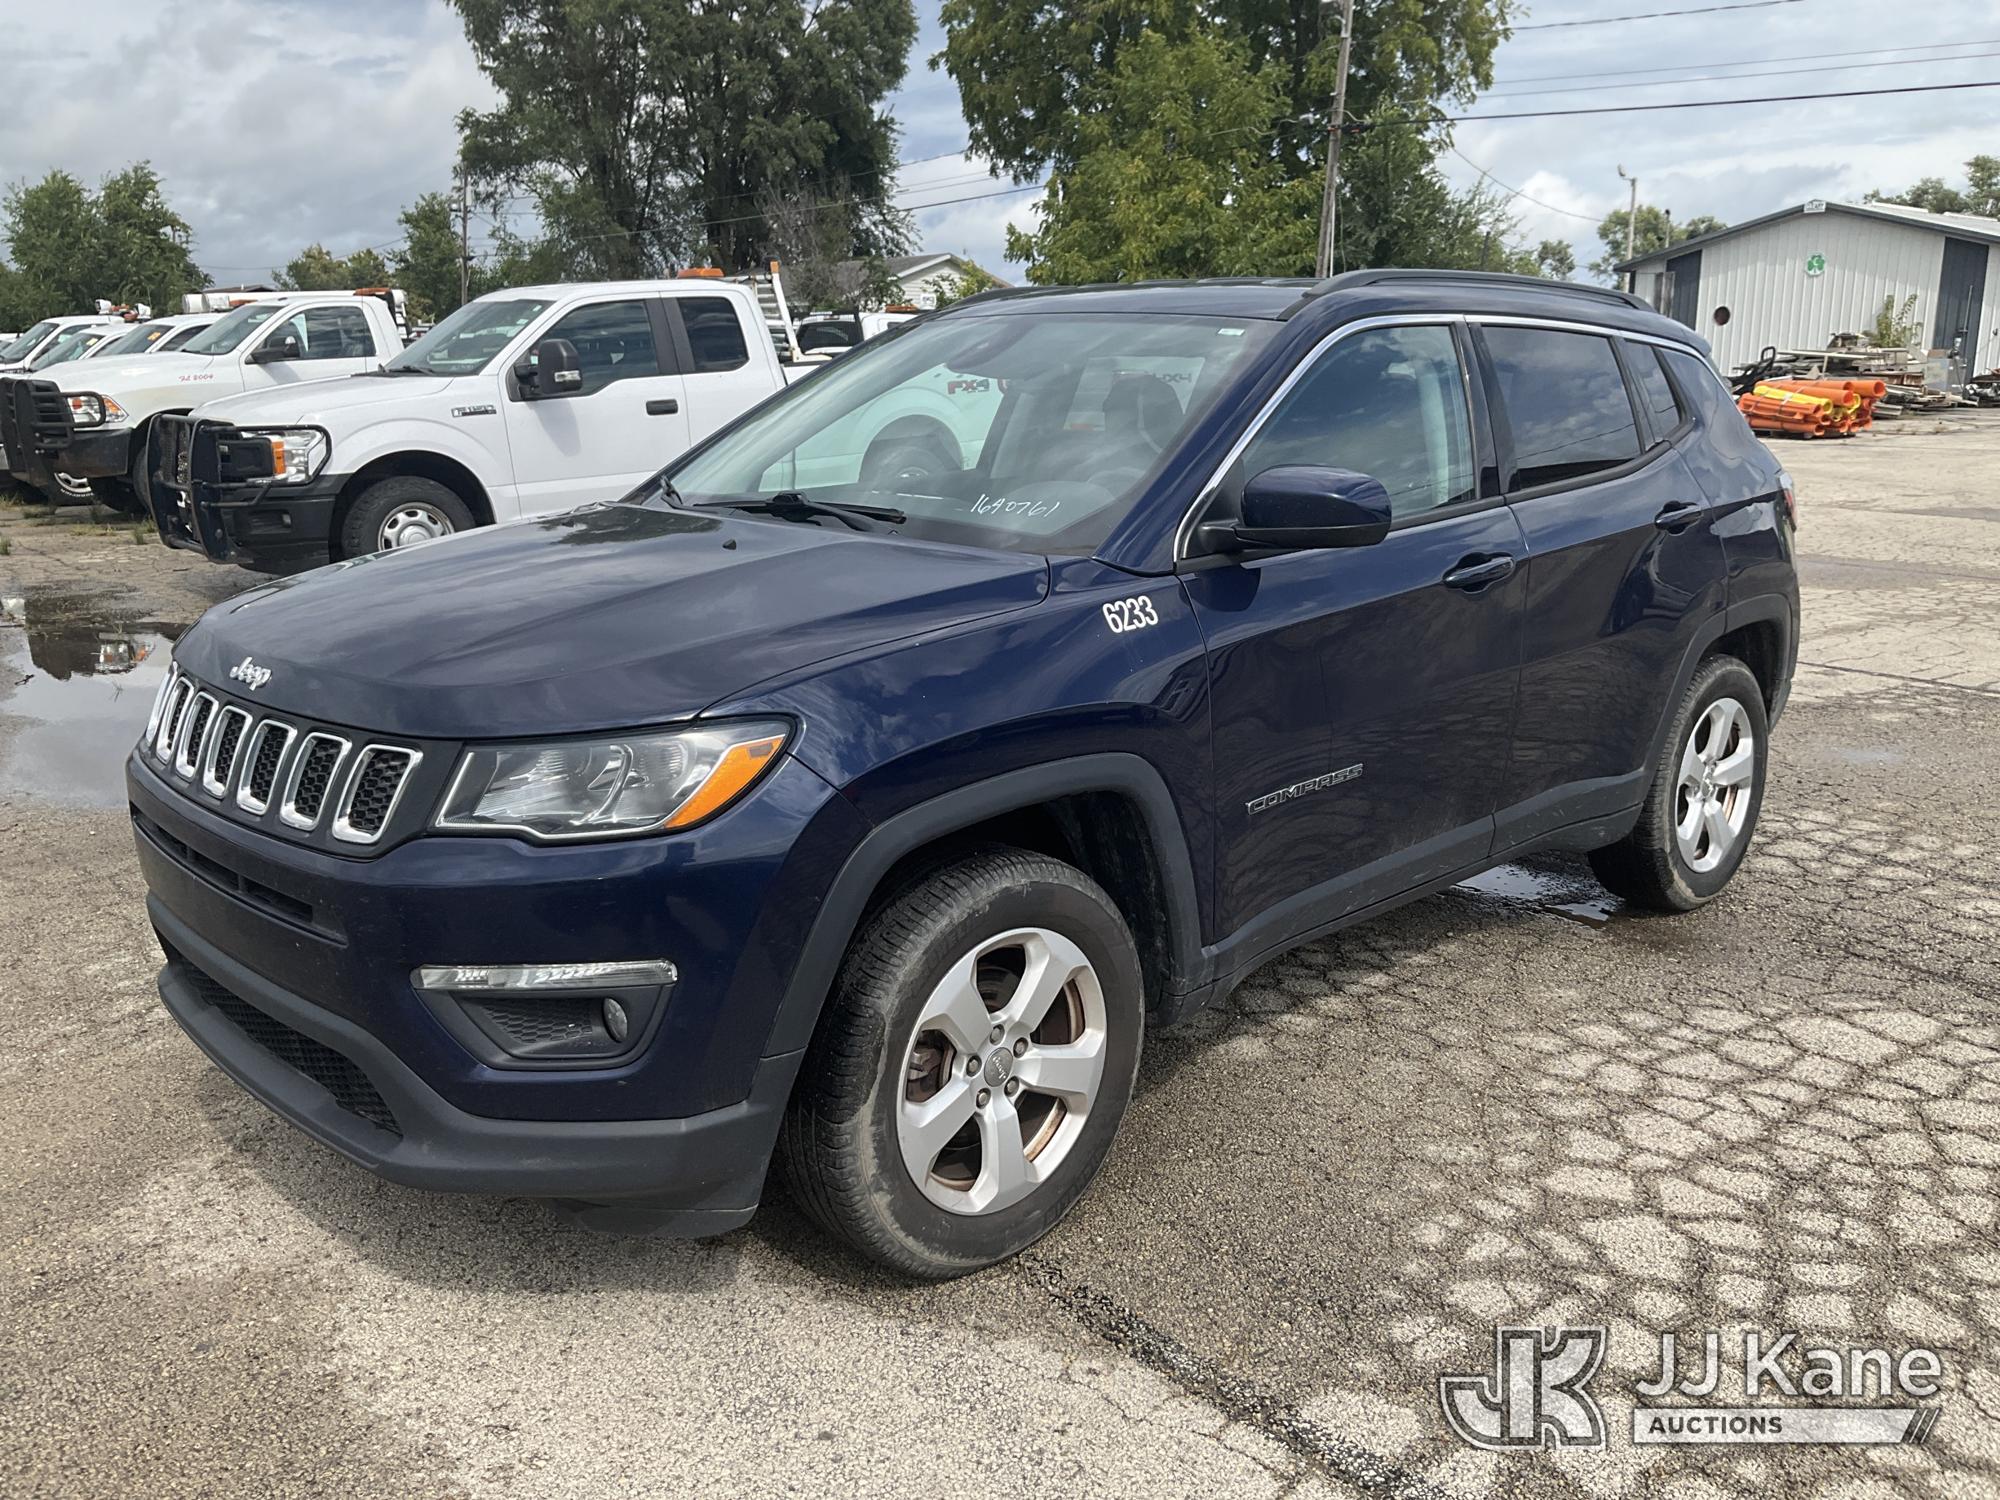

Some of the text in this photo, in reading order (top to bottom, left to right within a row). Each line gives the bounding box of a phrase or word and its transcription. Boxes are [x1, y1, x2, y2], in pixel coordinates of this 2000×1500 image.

[947, 378, 990, 395] FX4
[1102, 595, 1159, 633] 6233
[229, 656, 272, 691] Jeep
[1245, 763, 1364, 815] COMPASS
